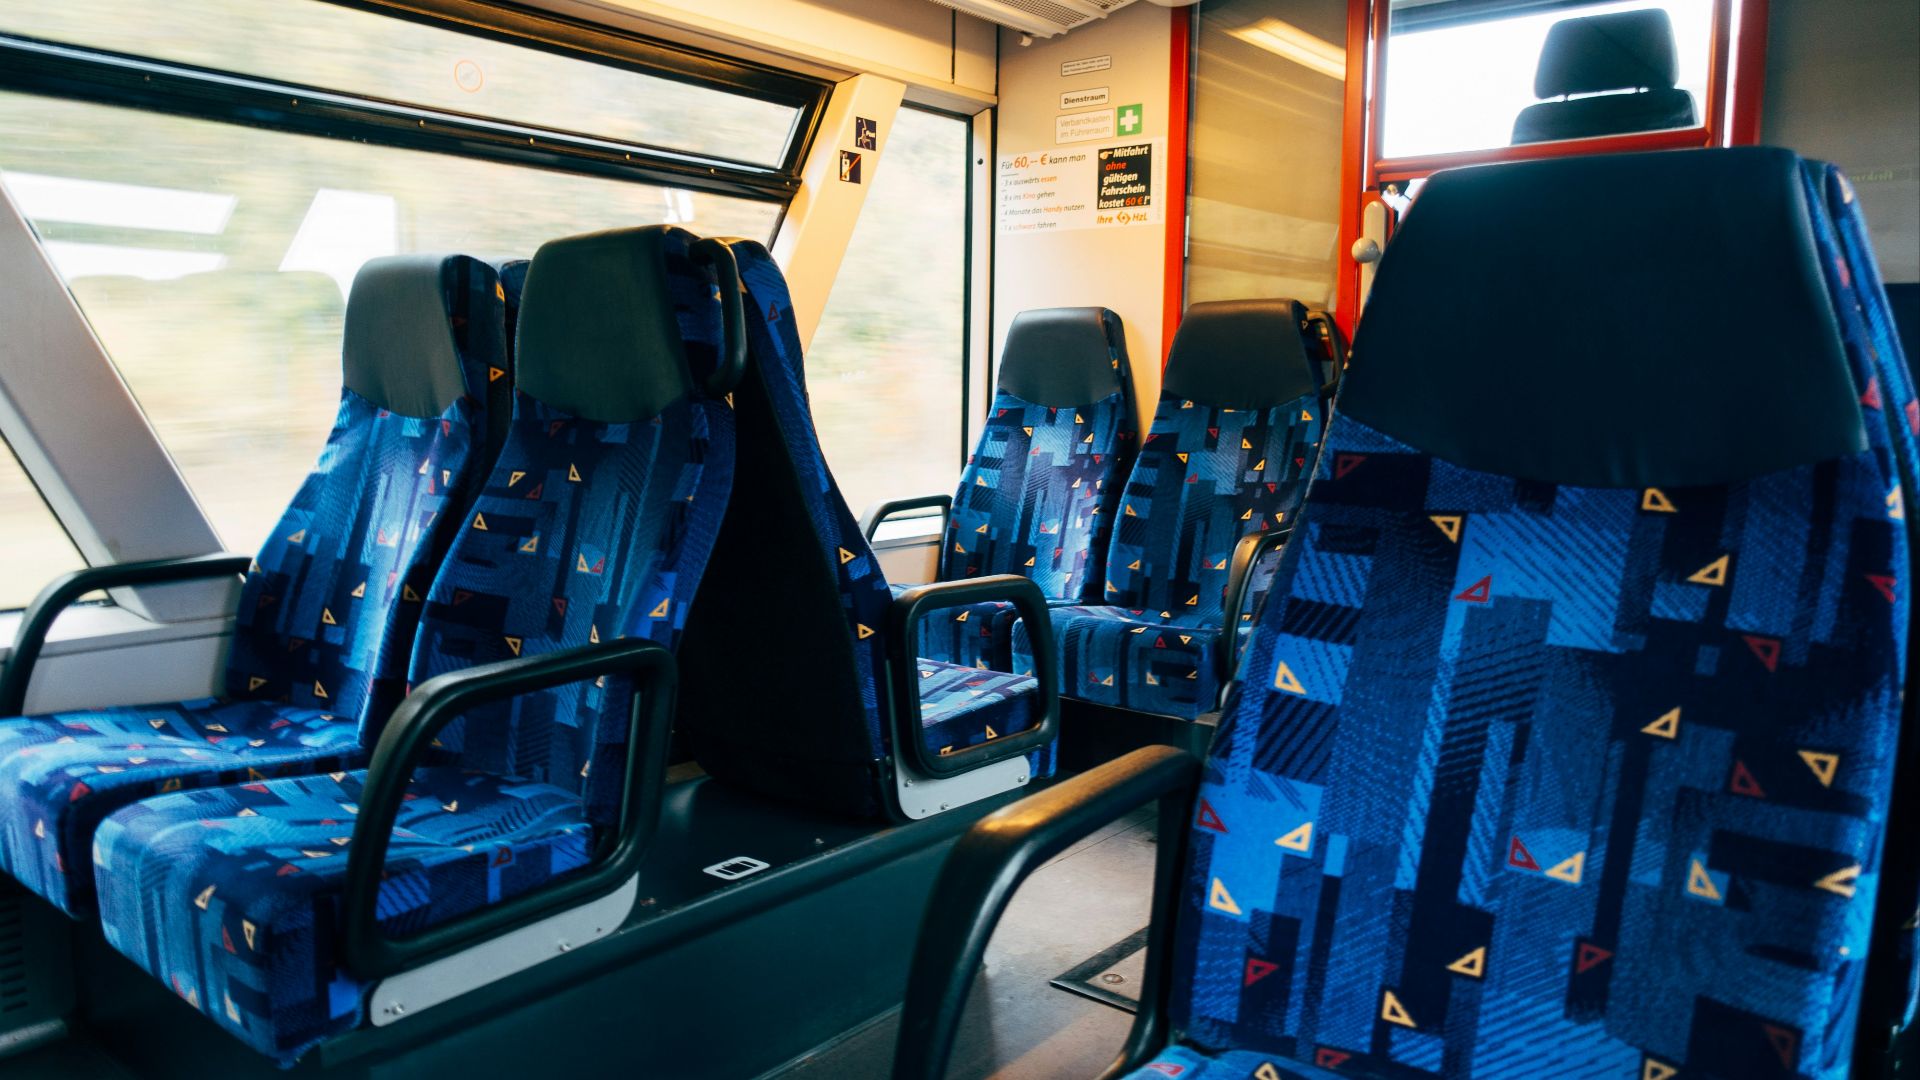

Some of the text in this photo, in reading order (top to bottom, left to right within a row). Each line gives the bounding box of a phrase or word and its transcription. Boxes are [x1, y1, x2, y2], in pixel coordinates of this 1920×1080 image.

[1064, 94, 1106, 105] Dienstraum
[1113, 146, 1148, 158] Mitfahrt
[1001, 161, 1013, 170] Für
[1040, 154, 1048, 165] €
[1049, 155, 1068, 164] kann
[1106, 161, 1126, 171] ohne
[1103, 173, 1138, 185] gültigen
[1036, 191, 1056, 200] gehen
[1101, 184, 1145, 196] Fahrschein
[1064, 204, 1085, 212] nutzen
[1098, 198, 1125, 209] kostet
[1125, 197, 1136, 207] 60
[1036, 220, 1057, 228] fahren
[1097, 214, 1114, 224] Ihre
